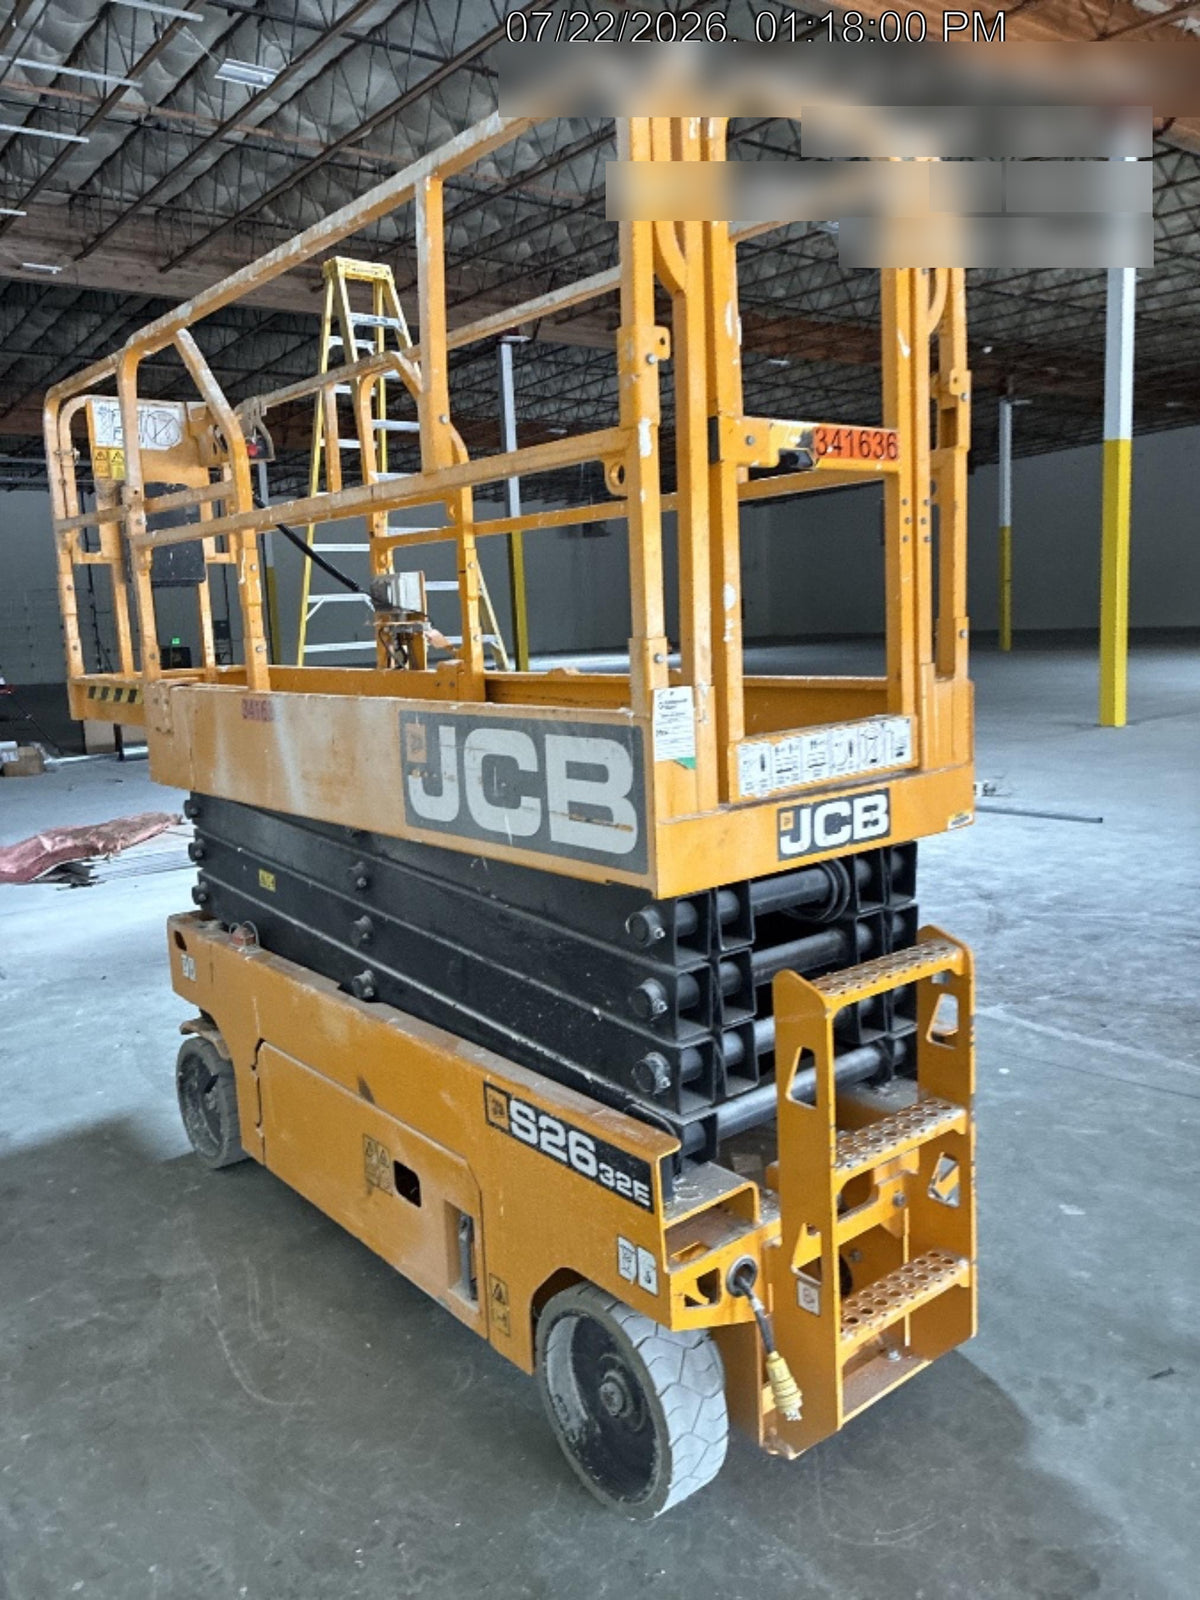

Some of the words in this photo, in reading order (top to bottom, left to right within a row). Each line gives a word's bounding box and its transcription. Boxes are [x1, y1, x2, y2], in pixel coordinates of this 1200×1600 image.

[815, 428, 897, 459] 341636
[408, 725, 638, 854] JCB
[780, 794, 889, 855] JCB
[509, 1099, 598, 1177] S26
